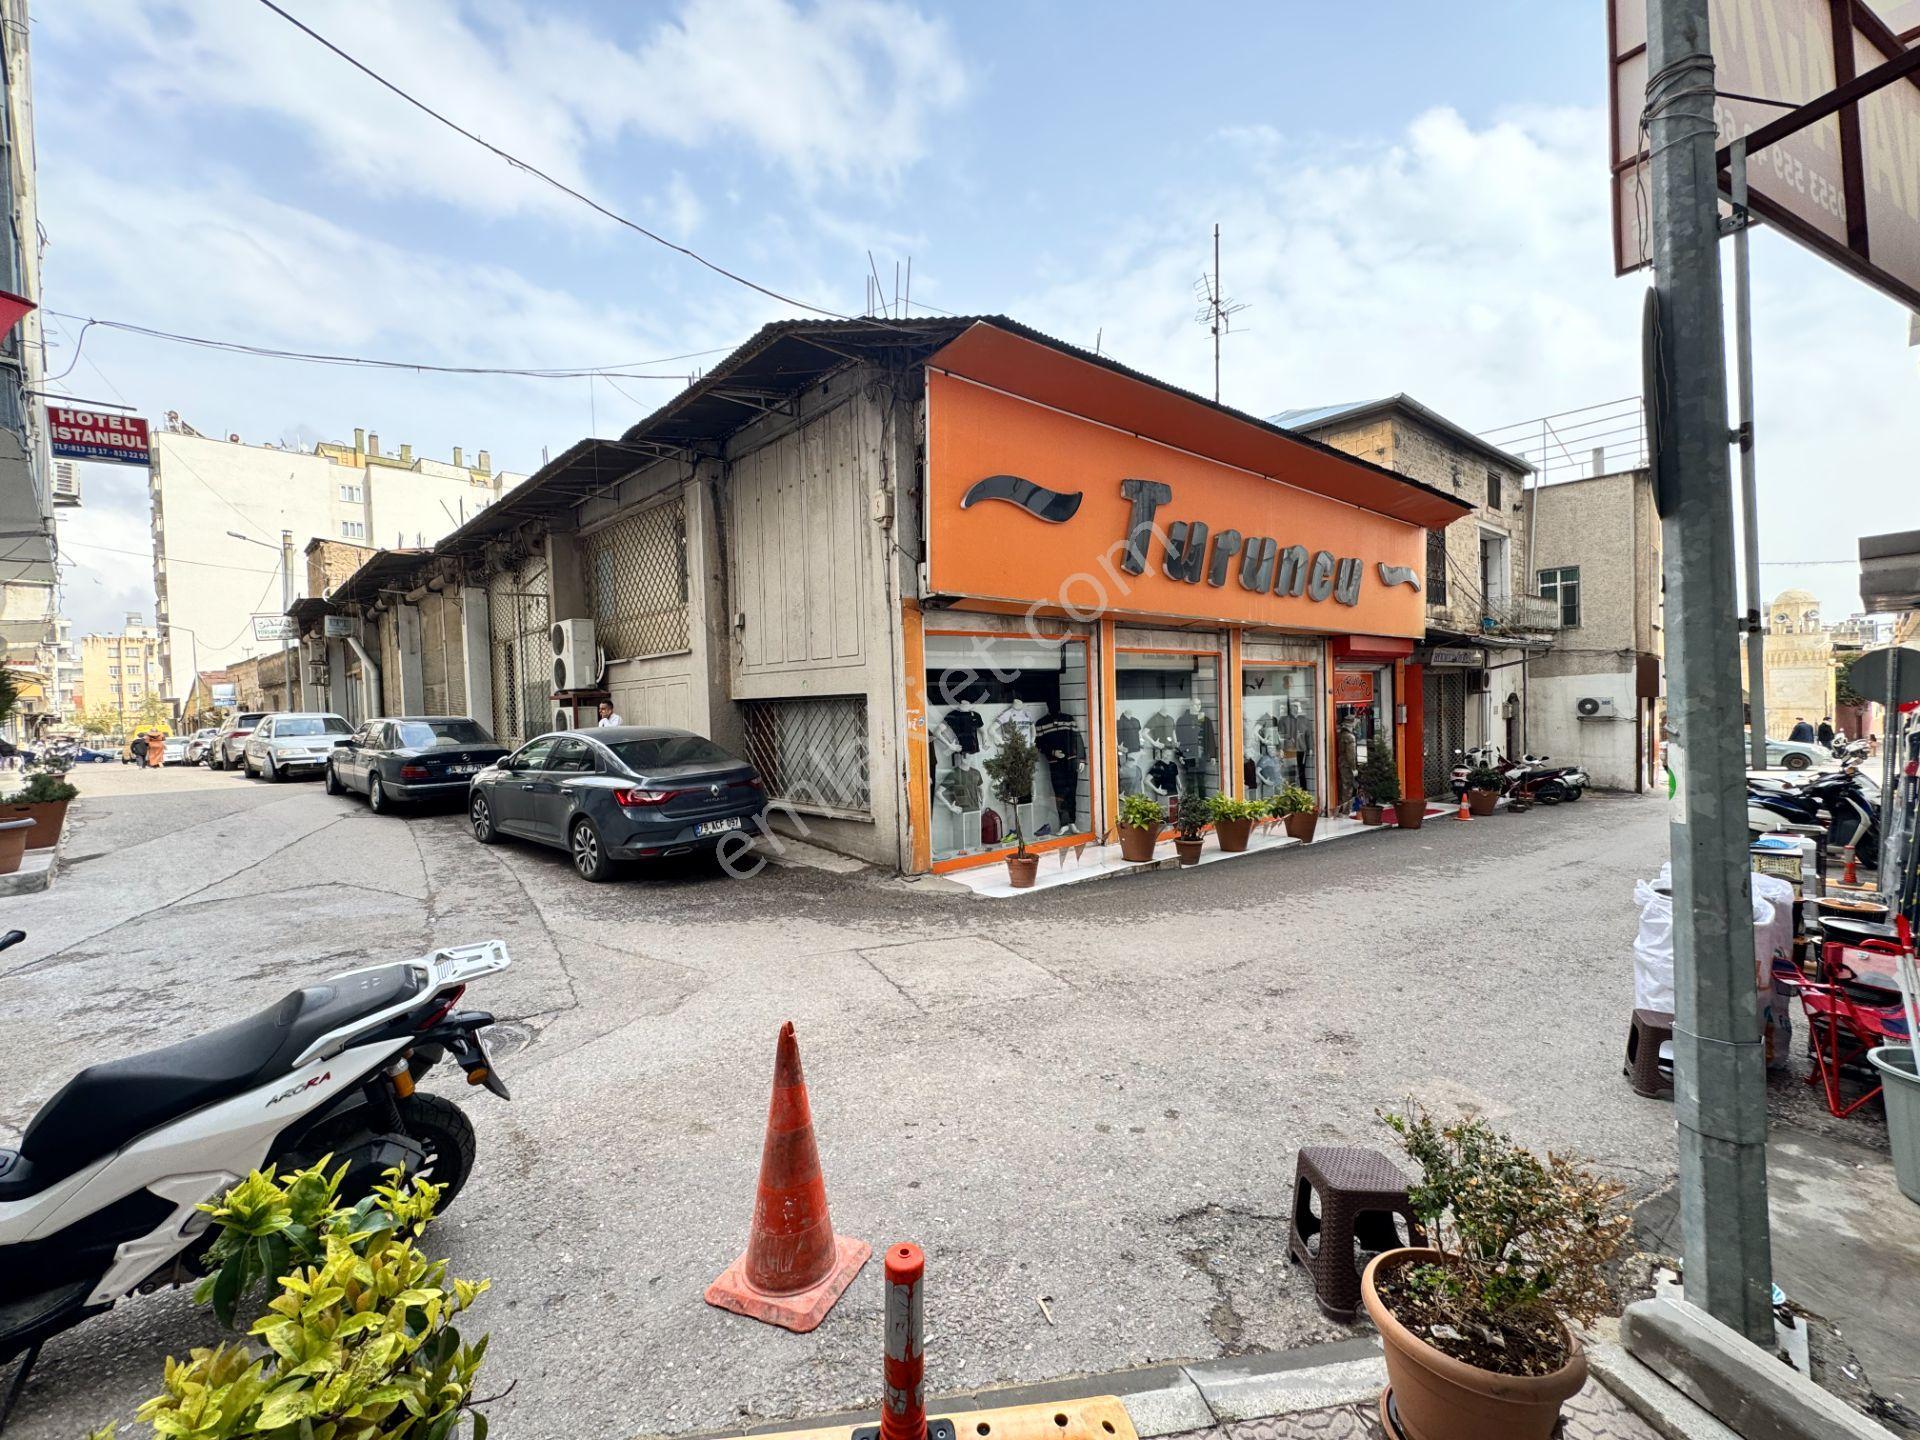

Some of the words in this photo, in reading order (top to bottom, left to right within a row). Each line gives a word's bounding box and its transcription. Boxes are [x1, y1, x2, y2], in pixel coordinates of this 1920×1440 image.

[51, 422, 147, 449] İSTANBUL
[59, 409, 137, 432] HOTEL
[1120, 479, 1363, 607] Turuncu
[265, 1071, 331, 1108] ARORA
